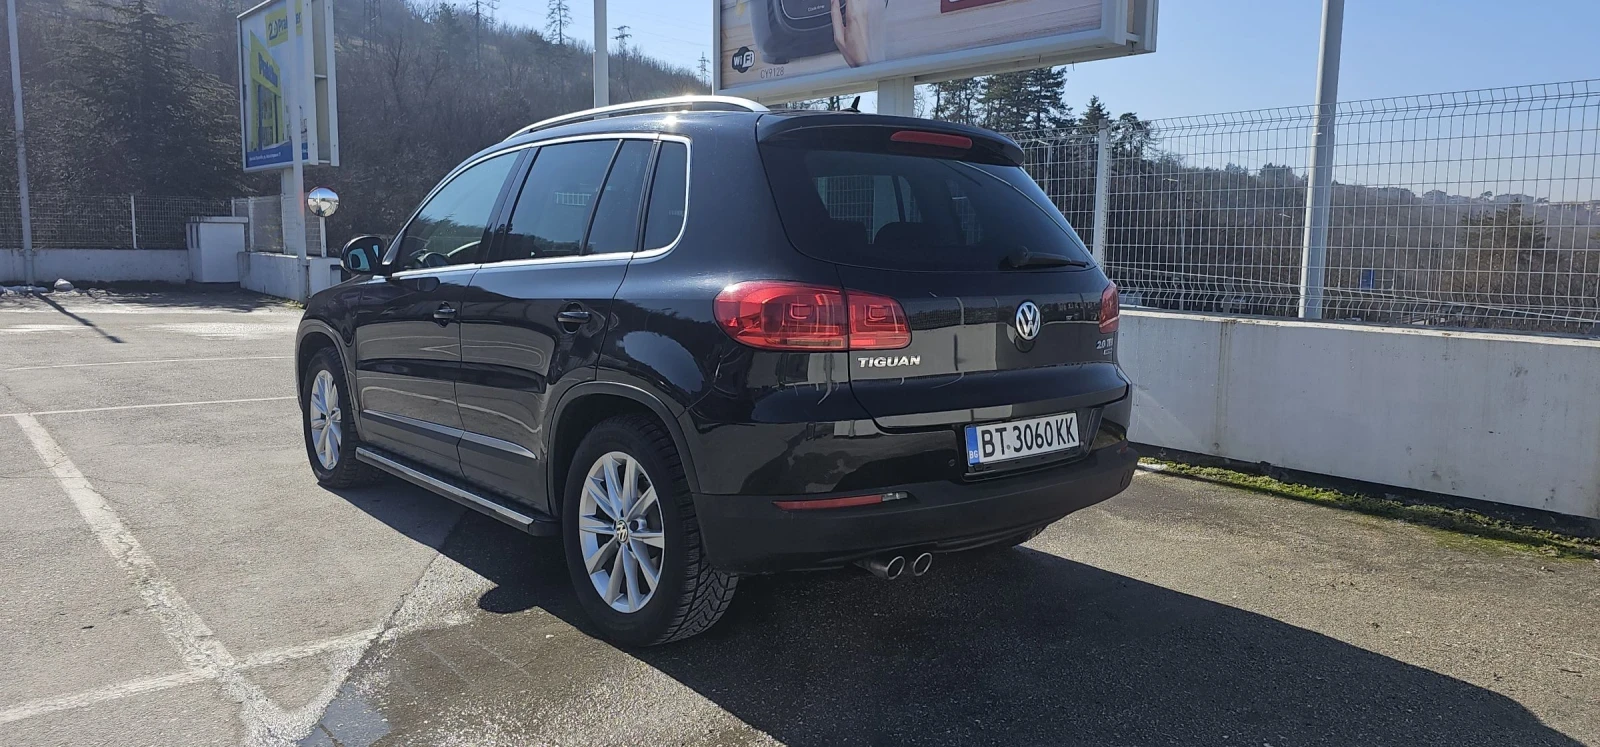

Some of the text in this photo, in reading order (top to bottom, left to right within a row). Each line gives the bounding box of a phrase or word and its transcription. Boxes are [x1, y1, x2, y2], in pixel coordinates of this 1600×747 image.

[760, 66, 785, 79] CY9128
[857, 355, 921, 368] TIGUAN
[969, 450, 979, 459] BG
